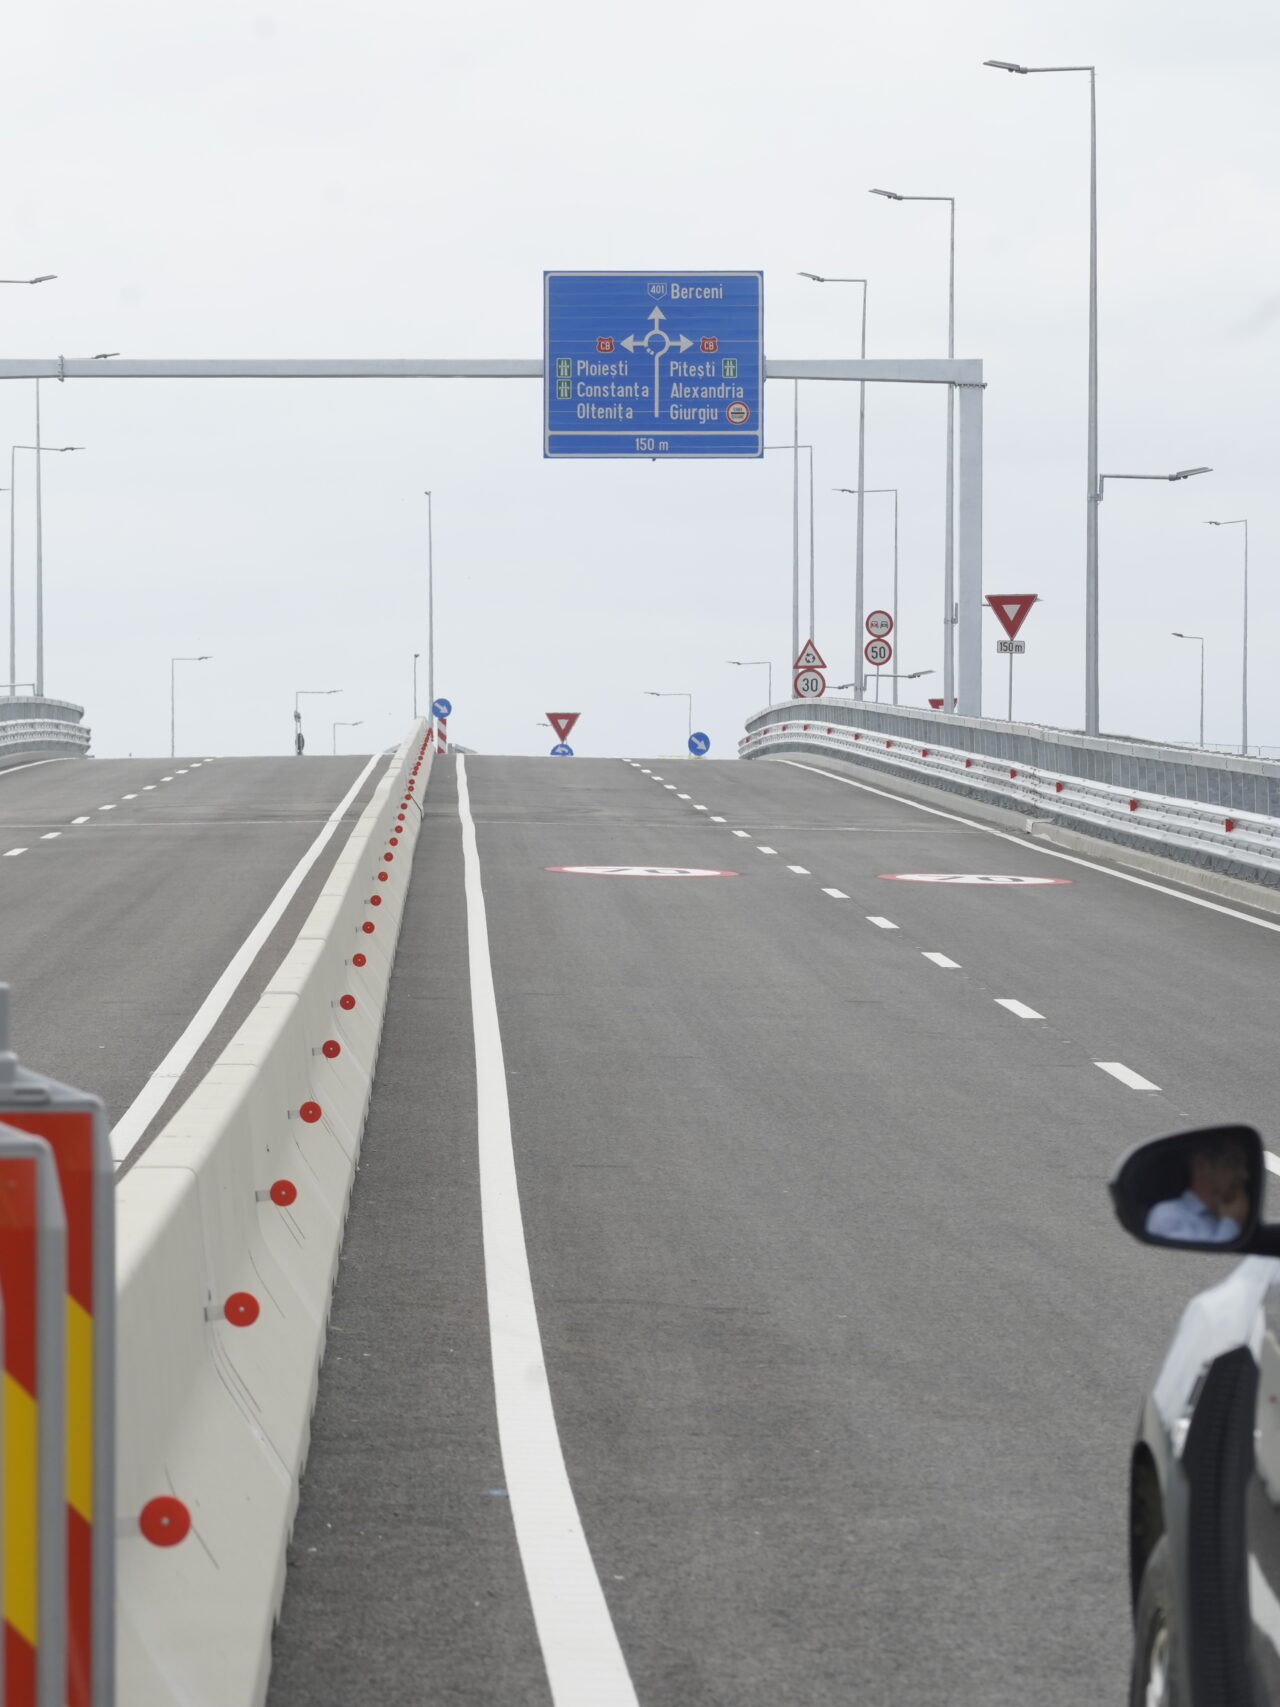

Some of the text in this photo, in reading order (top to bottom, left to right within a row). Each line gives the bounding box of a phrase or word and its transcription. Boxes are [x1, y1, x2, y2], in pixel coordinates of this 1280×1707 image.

[650, 283, 723, 299] 401 Berceni
[577, 360, 628, 378] Ploiești
[670, 360, 715, 379] Pitești
[577, 382, 649, 400] Constanța
[670, 383, 744, 398] Alexandria
[577, 403, 633, 422] Oltenița
[670, 404, 718, 424] Giurgiu
[635, 438, 669, 451] 150 m
[871, 646, 886, 659] 50
[999, 641, 1023, 652] 150 m
[802, 678, 818, 692] 30
